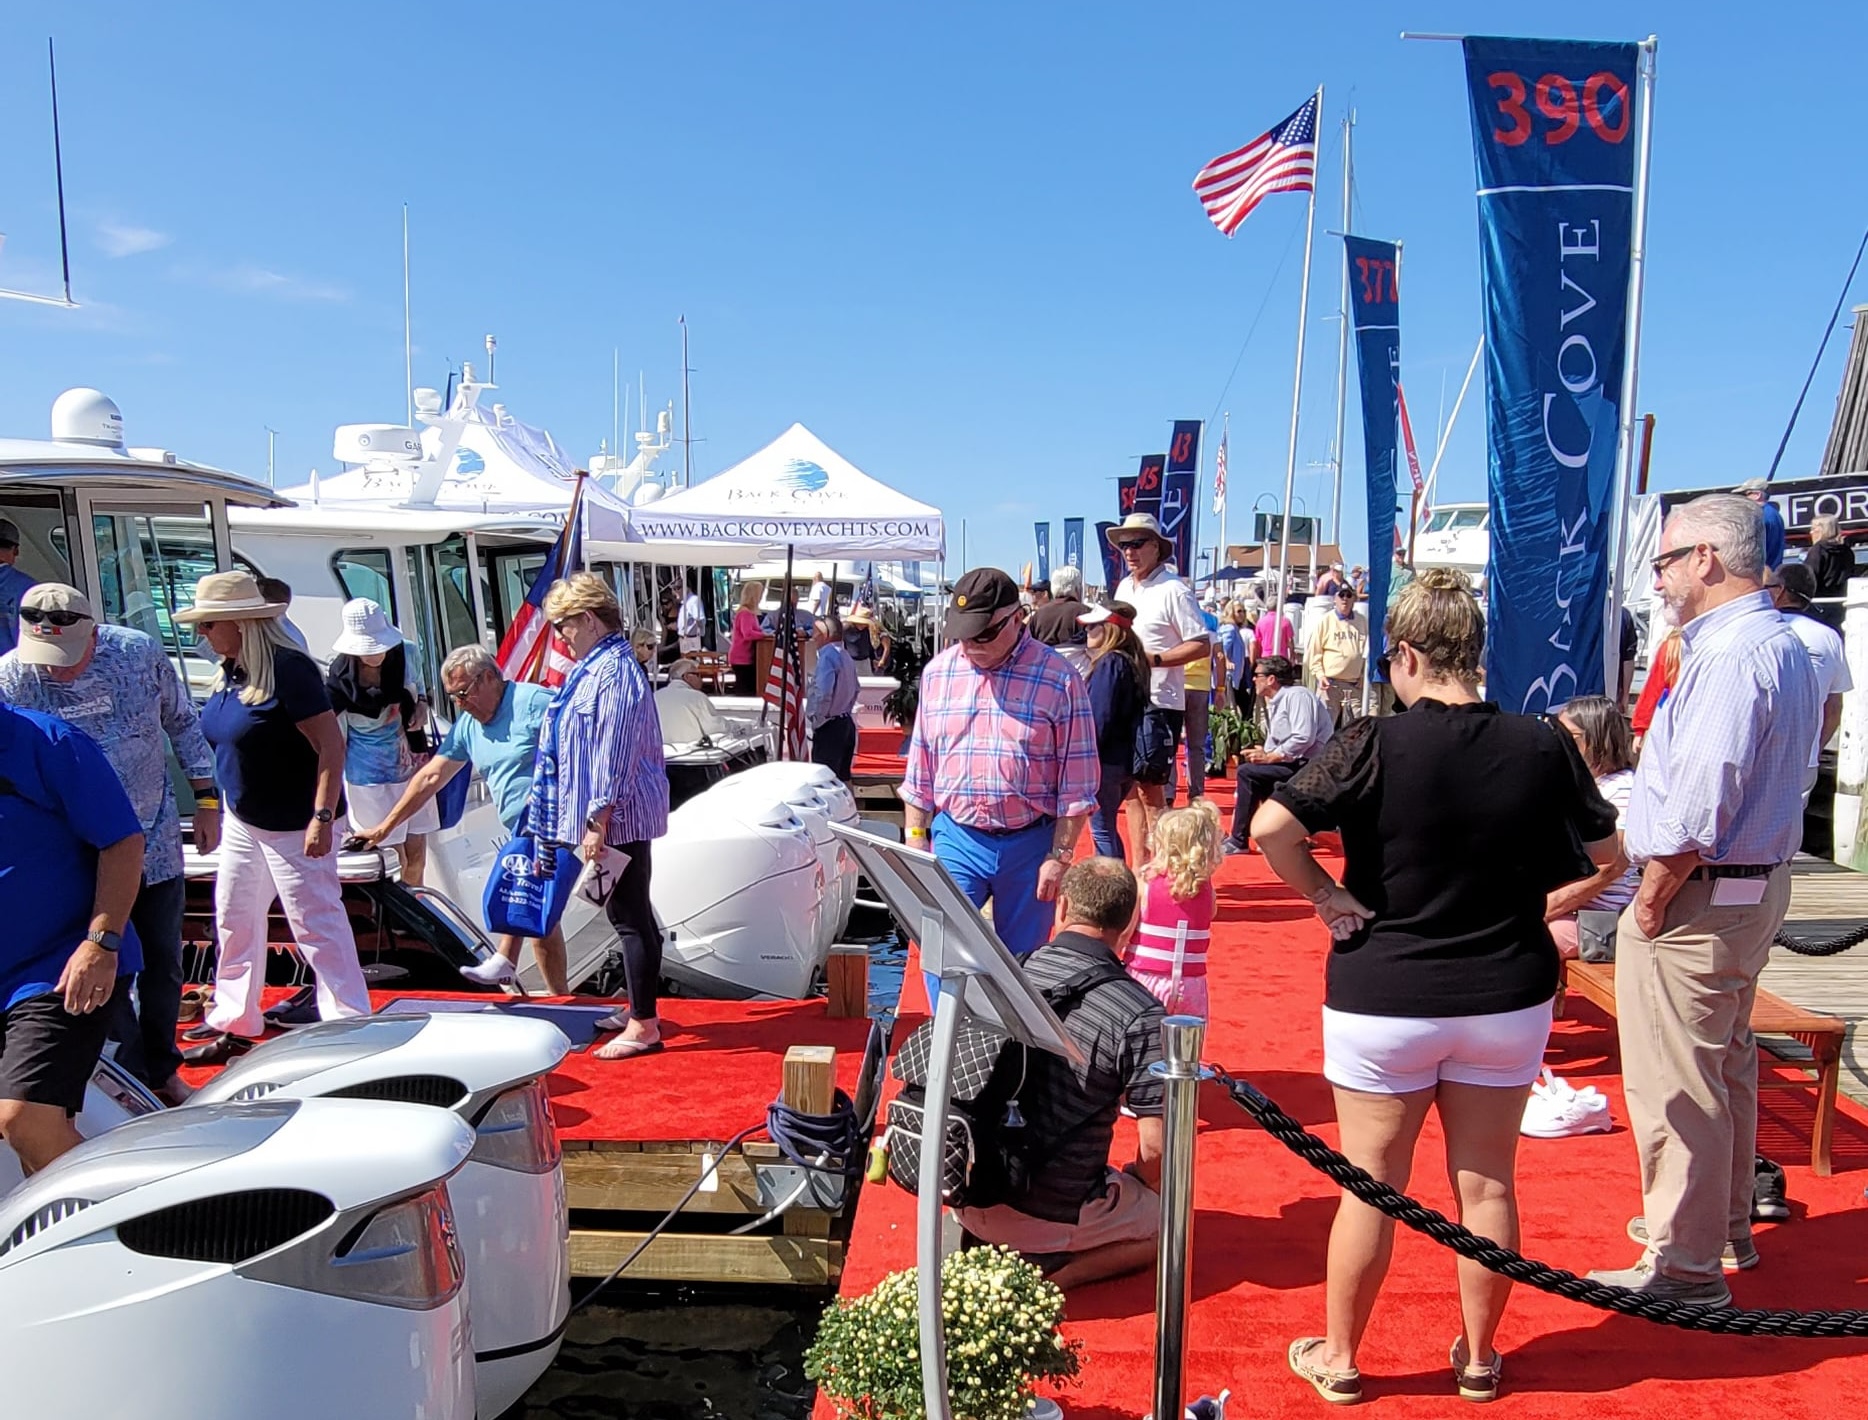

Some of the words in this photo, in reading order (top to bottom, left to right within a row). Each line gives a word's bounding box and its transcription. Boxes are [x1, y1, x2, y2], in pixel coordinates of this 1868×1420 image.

[1487, 71, 1630, 146] 390
[1543, 218, 1604, 469] COVE
[1171, 432, 1192, 464] 43
[640, 521, 930, 537] WWW.BACKCOVEYACHTS.COM
